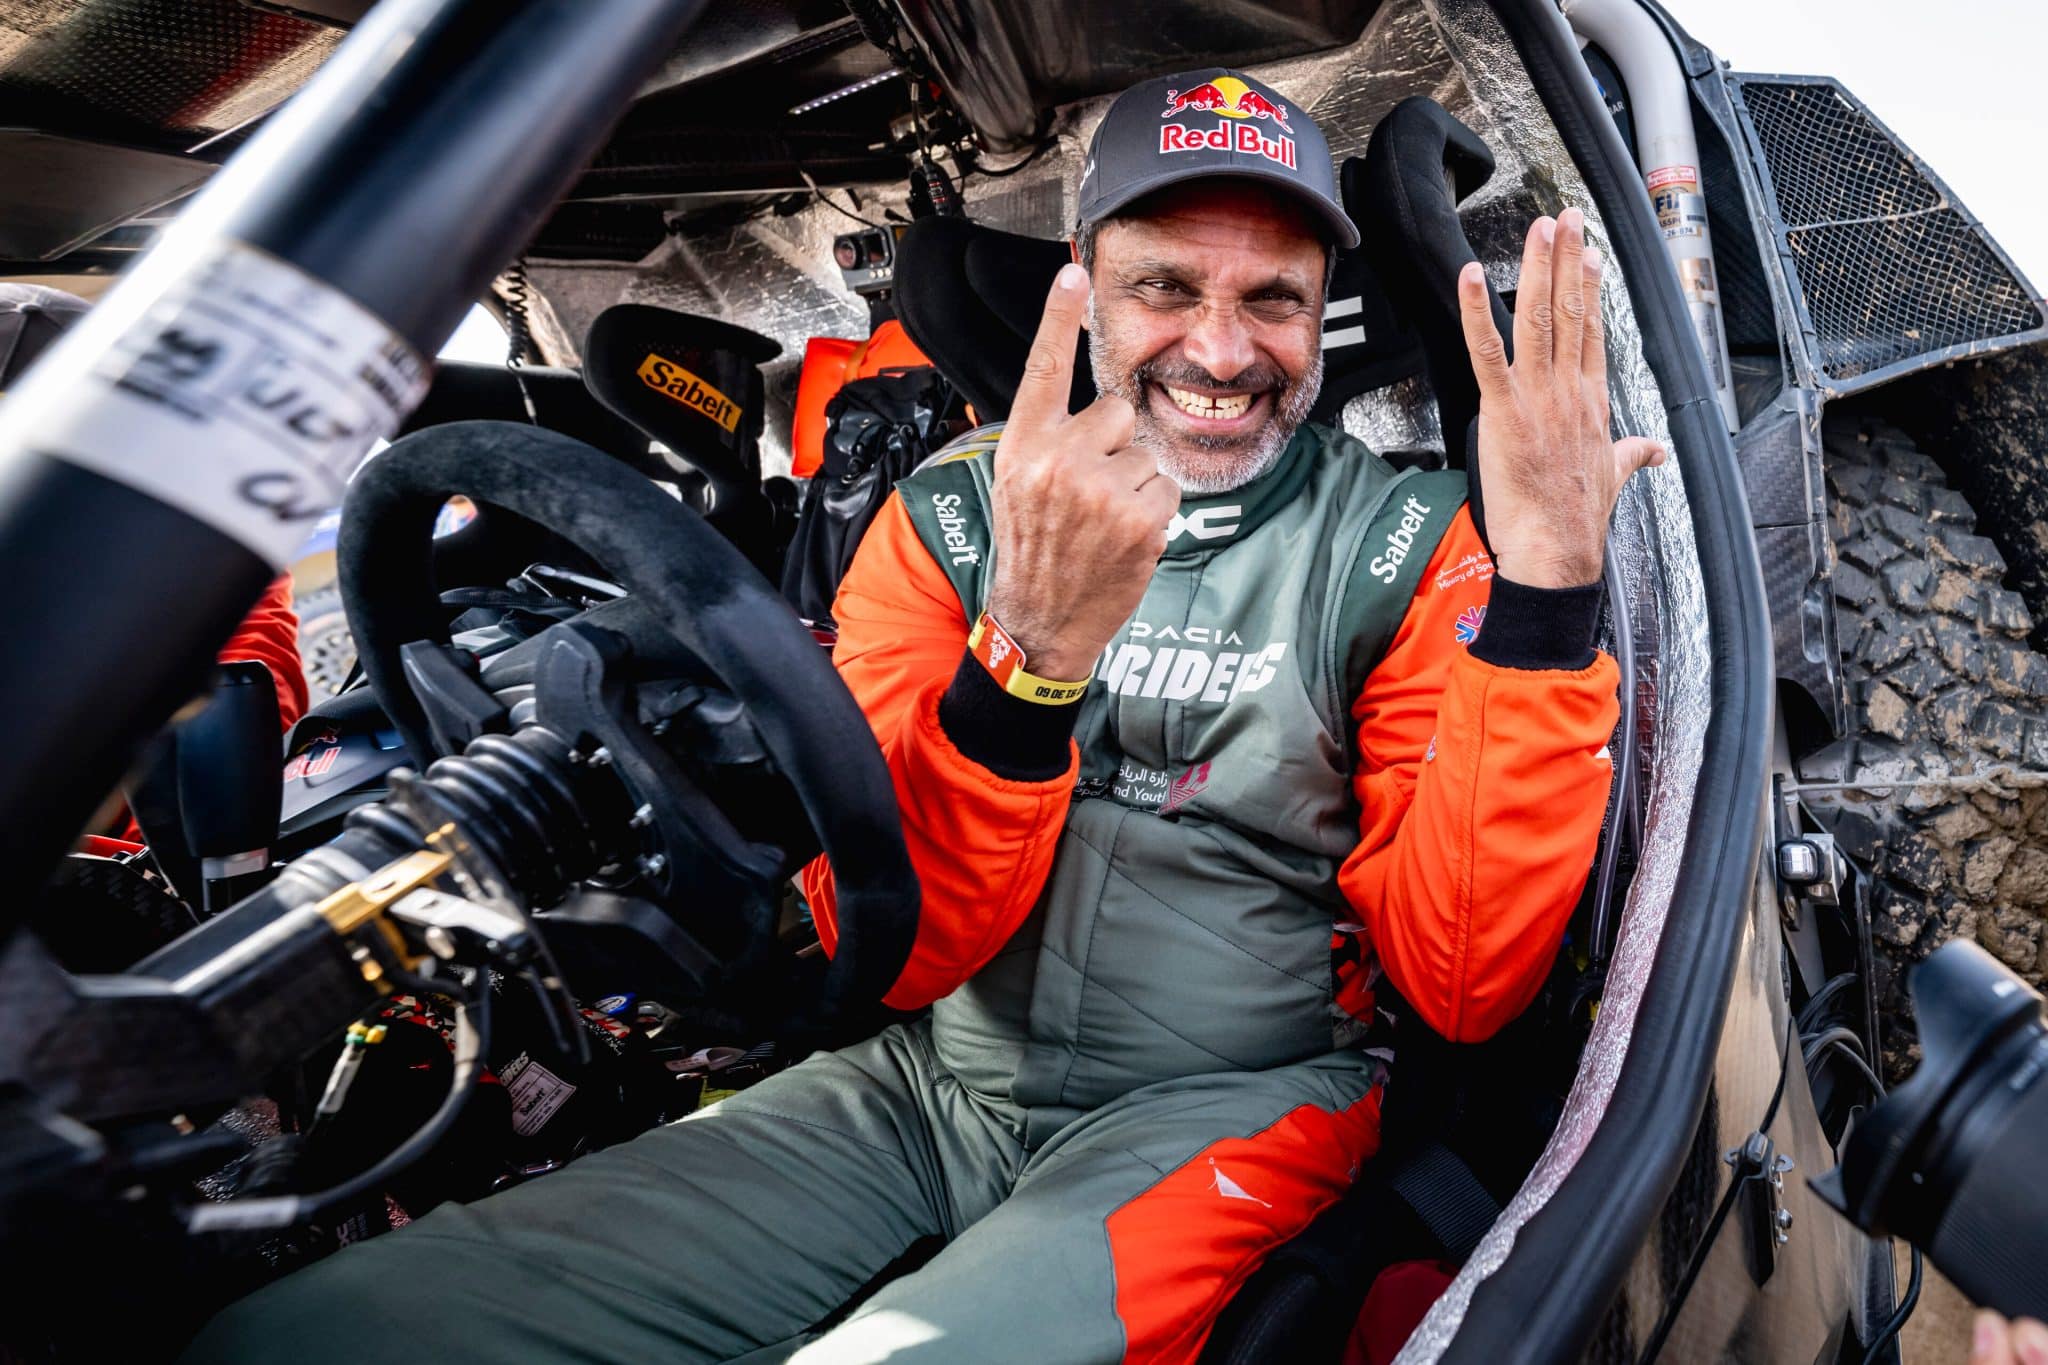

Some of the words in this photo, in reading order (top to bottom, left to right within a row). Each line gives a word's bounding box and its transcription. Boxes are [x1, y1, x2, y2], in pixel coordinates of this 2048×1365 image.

[1159, 120, 1231, 153] Red
[1235, 123, 1297, 171] Bull
[646, 361, 733, 425] Sabelt
[932, 493, 981, 567] Sabelt
[1370, 493, 1431, 584] Sabelt
[1466, 567, 1475, 577] of
[1129, 621, 1243, 646] DACIA
[1035, 686, 1051, 698] 09
[1113, 785, 1131, 798] nd
